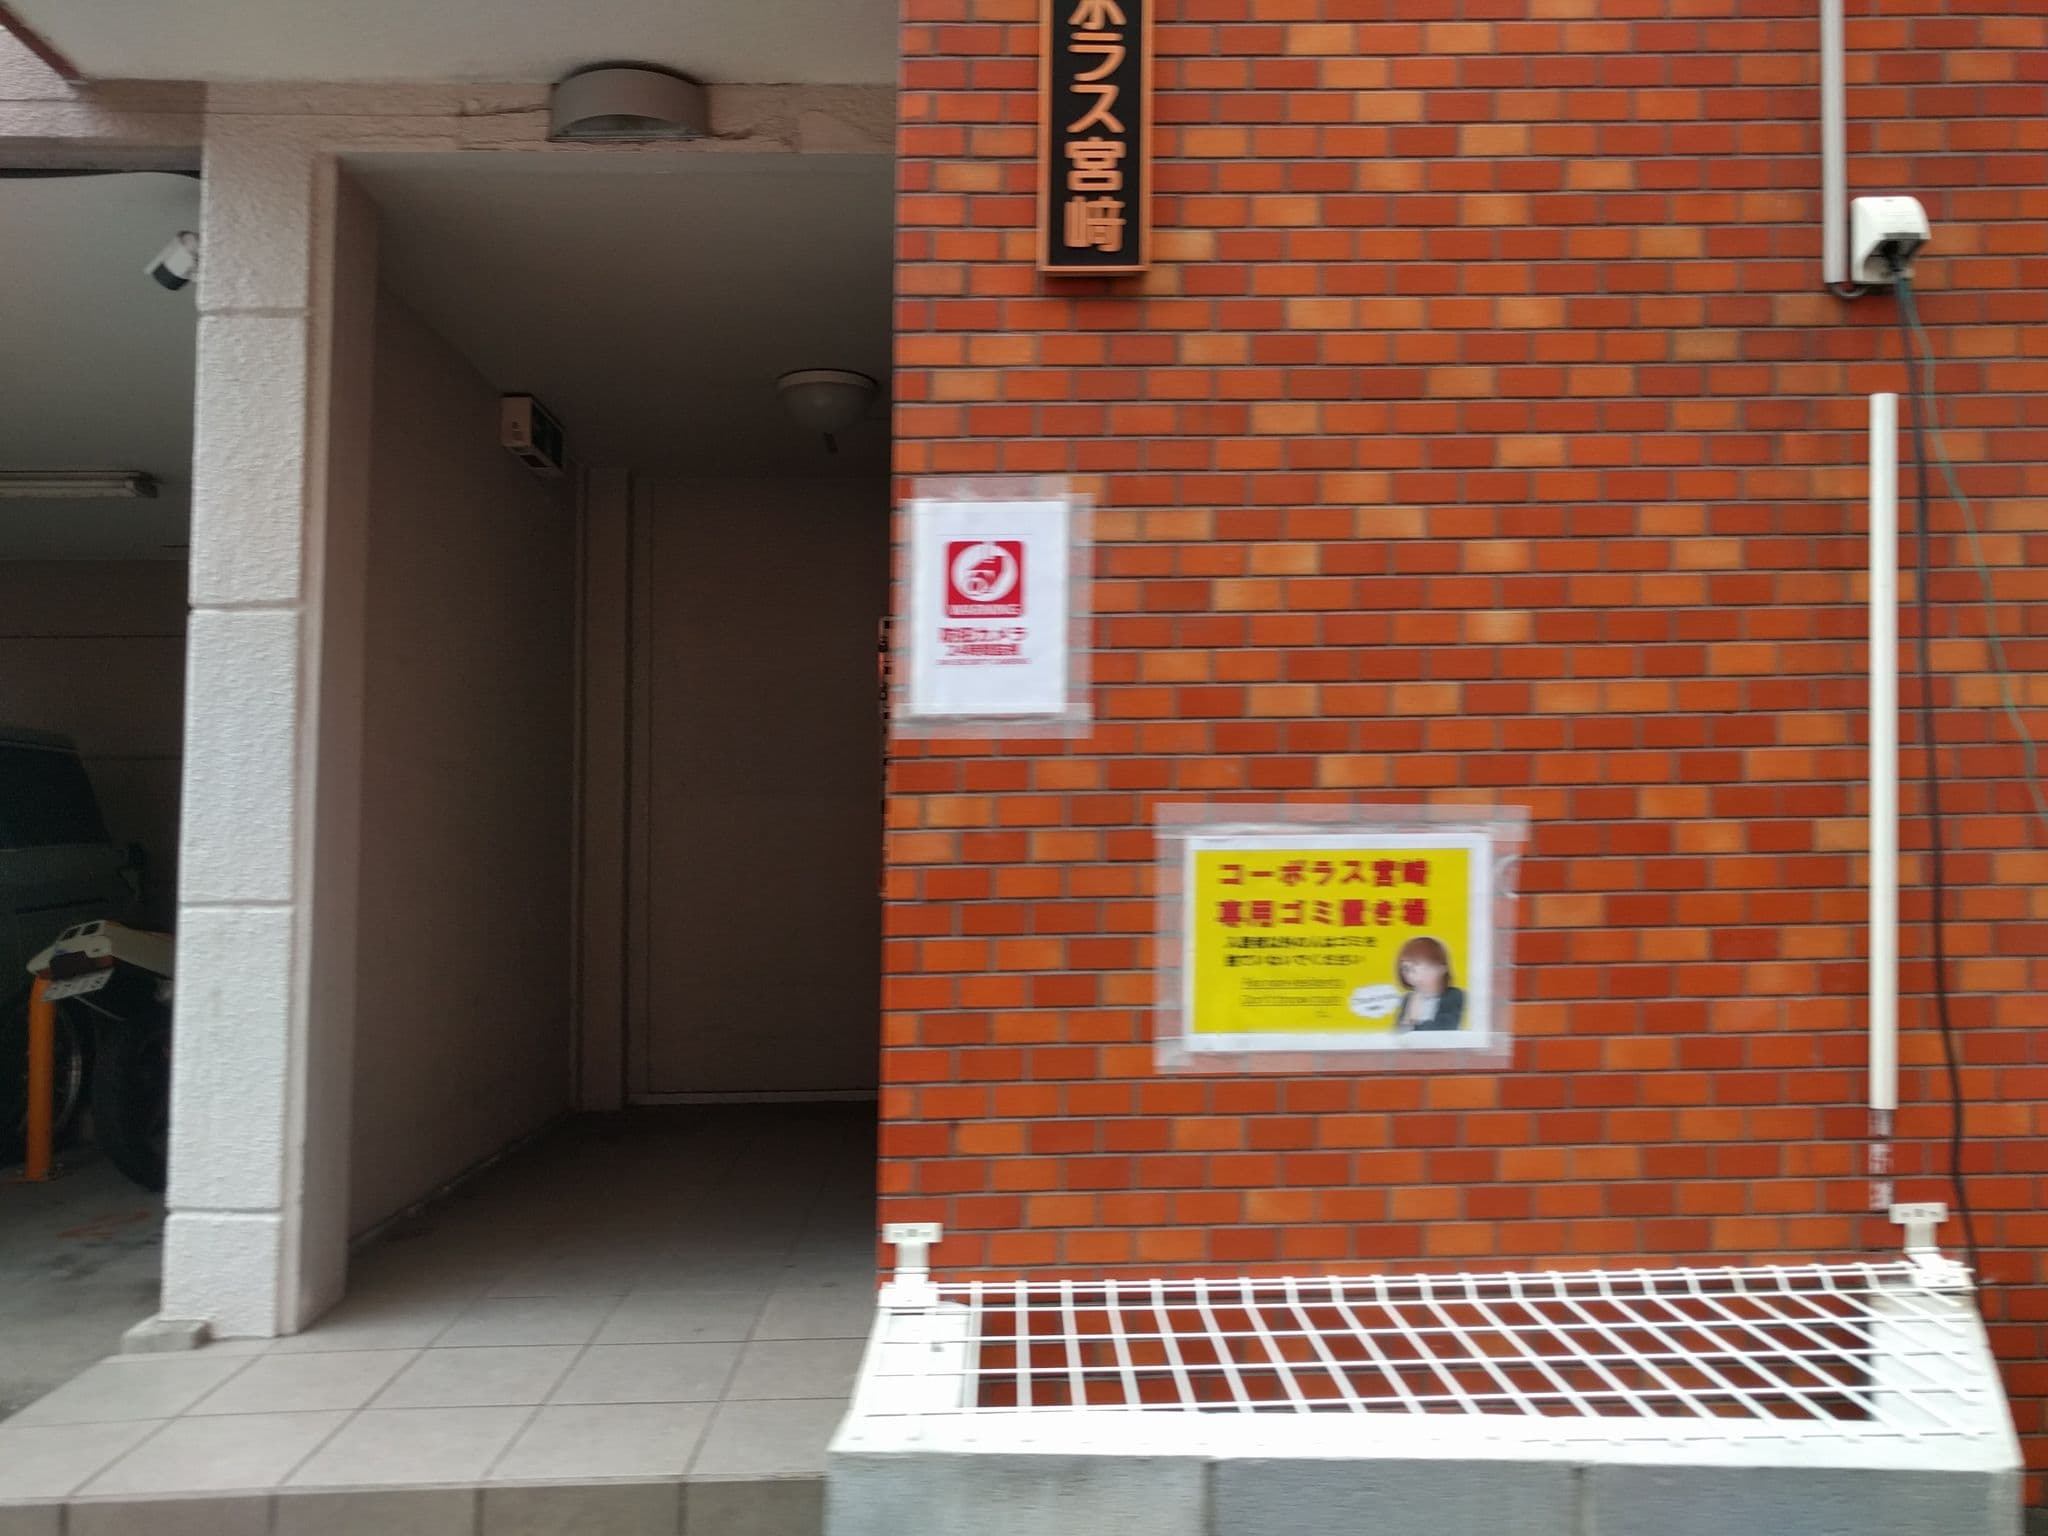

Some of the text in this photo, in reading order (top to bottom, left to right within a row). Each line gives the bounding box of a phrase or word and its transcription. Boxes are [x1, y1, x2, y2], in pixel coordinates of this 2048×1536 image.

[1217, 899, 1430, 927] 専用ゴミ置き場
